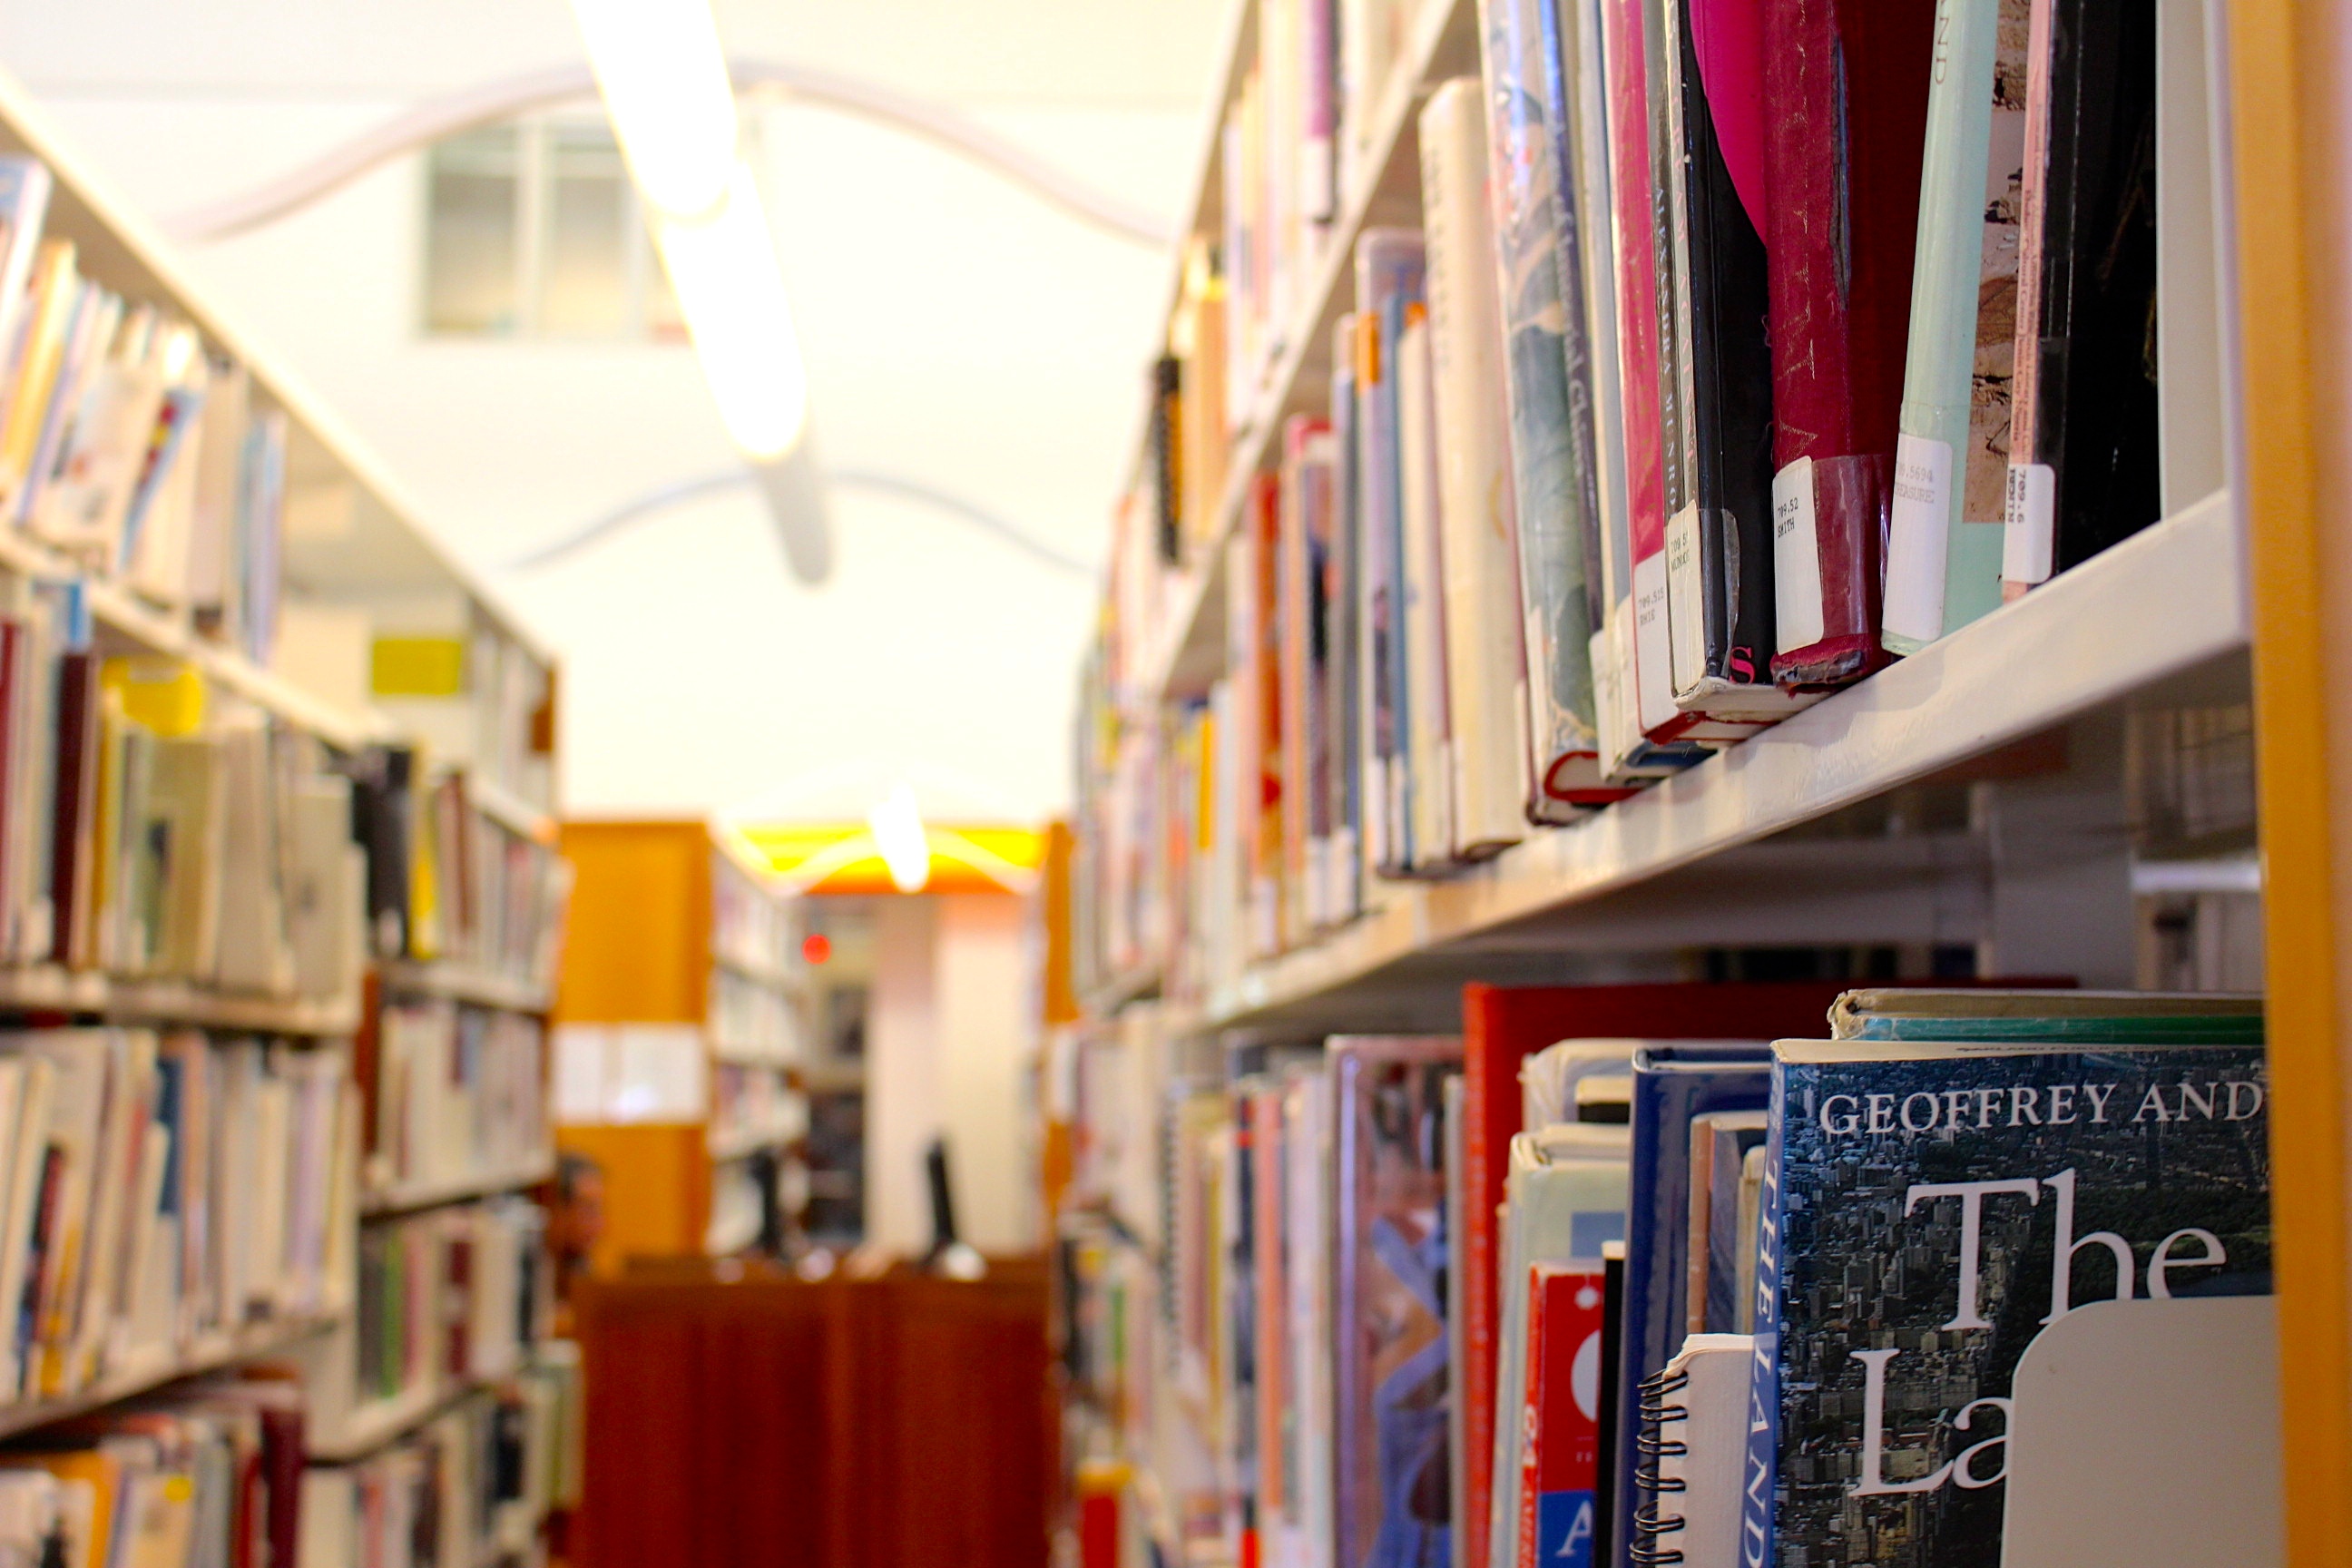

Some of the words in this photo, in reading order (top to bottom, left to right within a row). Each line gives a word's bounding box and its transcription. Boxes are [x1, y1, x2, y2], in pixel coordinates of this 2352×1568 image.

[1935, 0, 1950, 85] ND
[1656, 188, 1671, 376] ALEXANDRA
[1777, 497, 1798, 518] 709.52
[1778, 516, 1795, 538] SMITH
[1818, 1083, 2118, 1136] GEOFFREY
[2132, 1080, 2265, 1125] AND
[1757, 1159, 1779, 1324] THE
[1904, 1167, 2228, 1330] The
